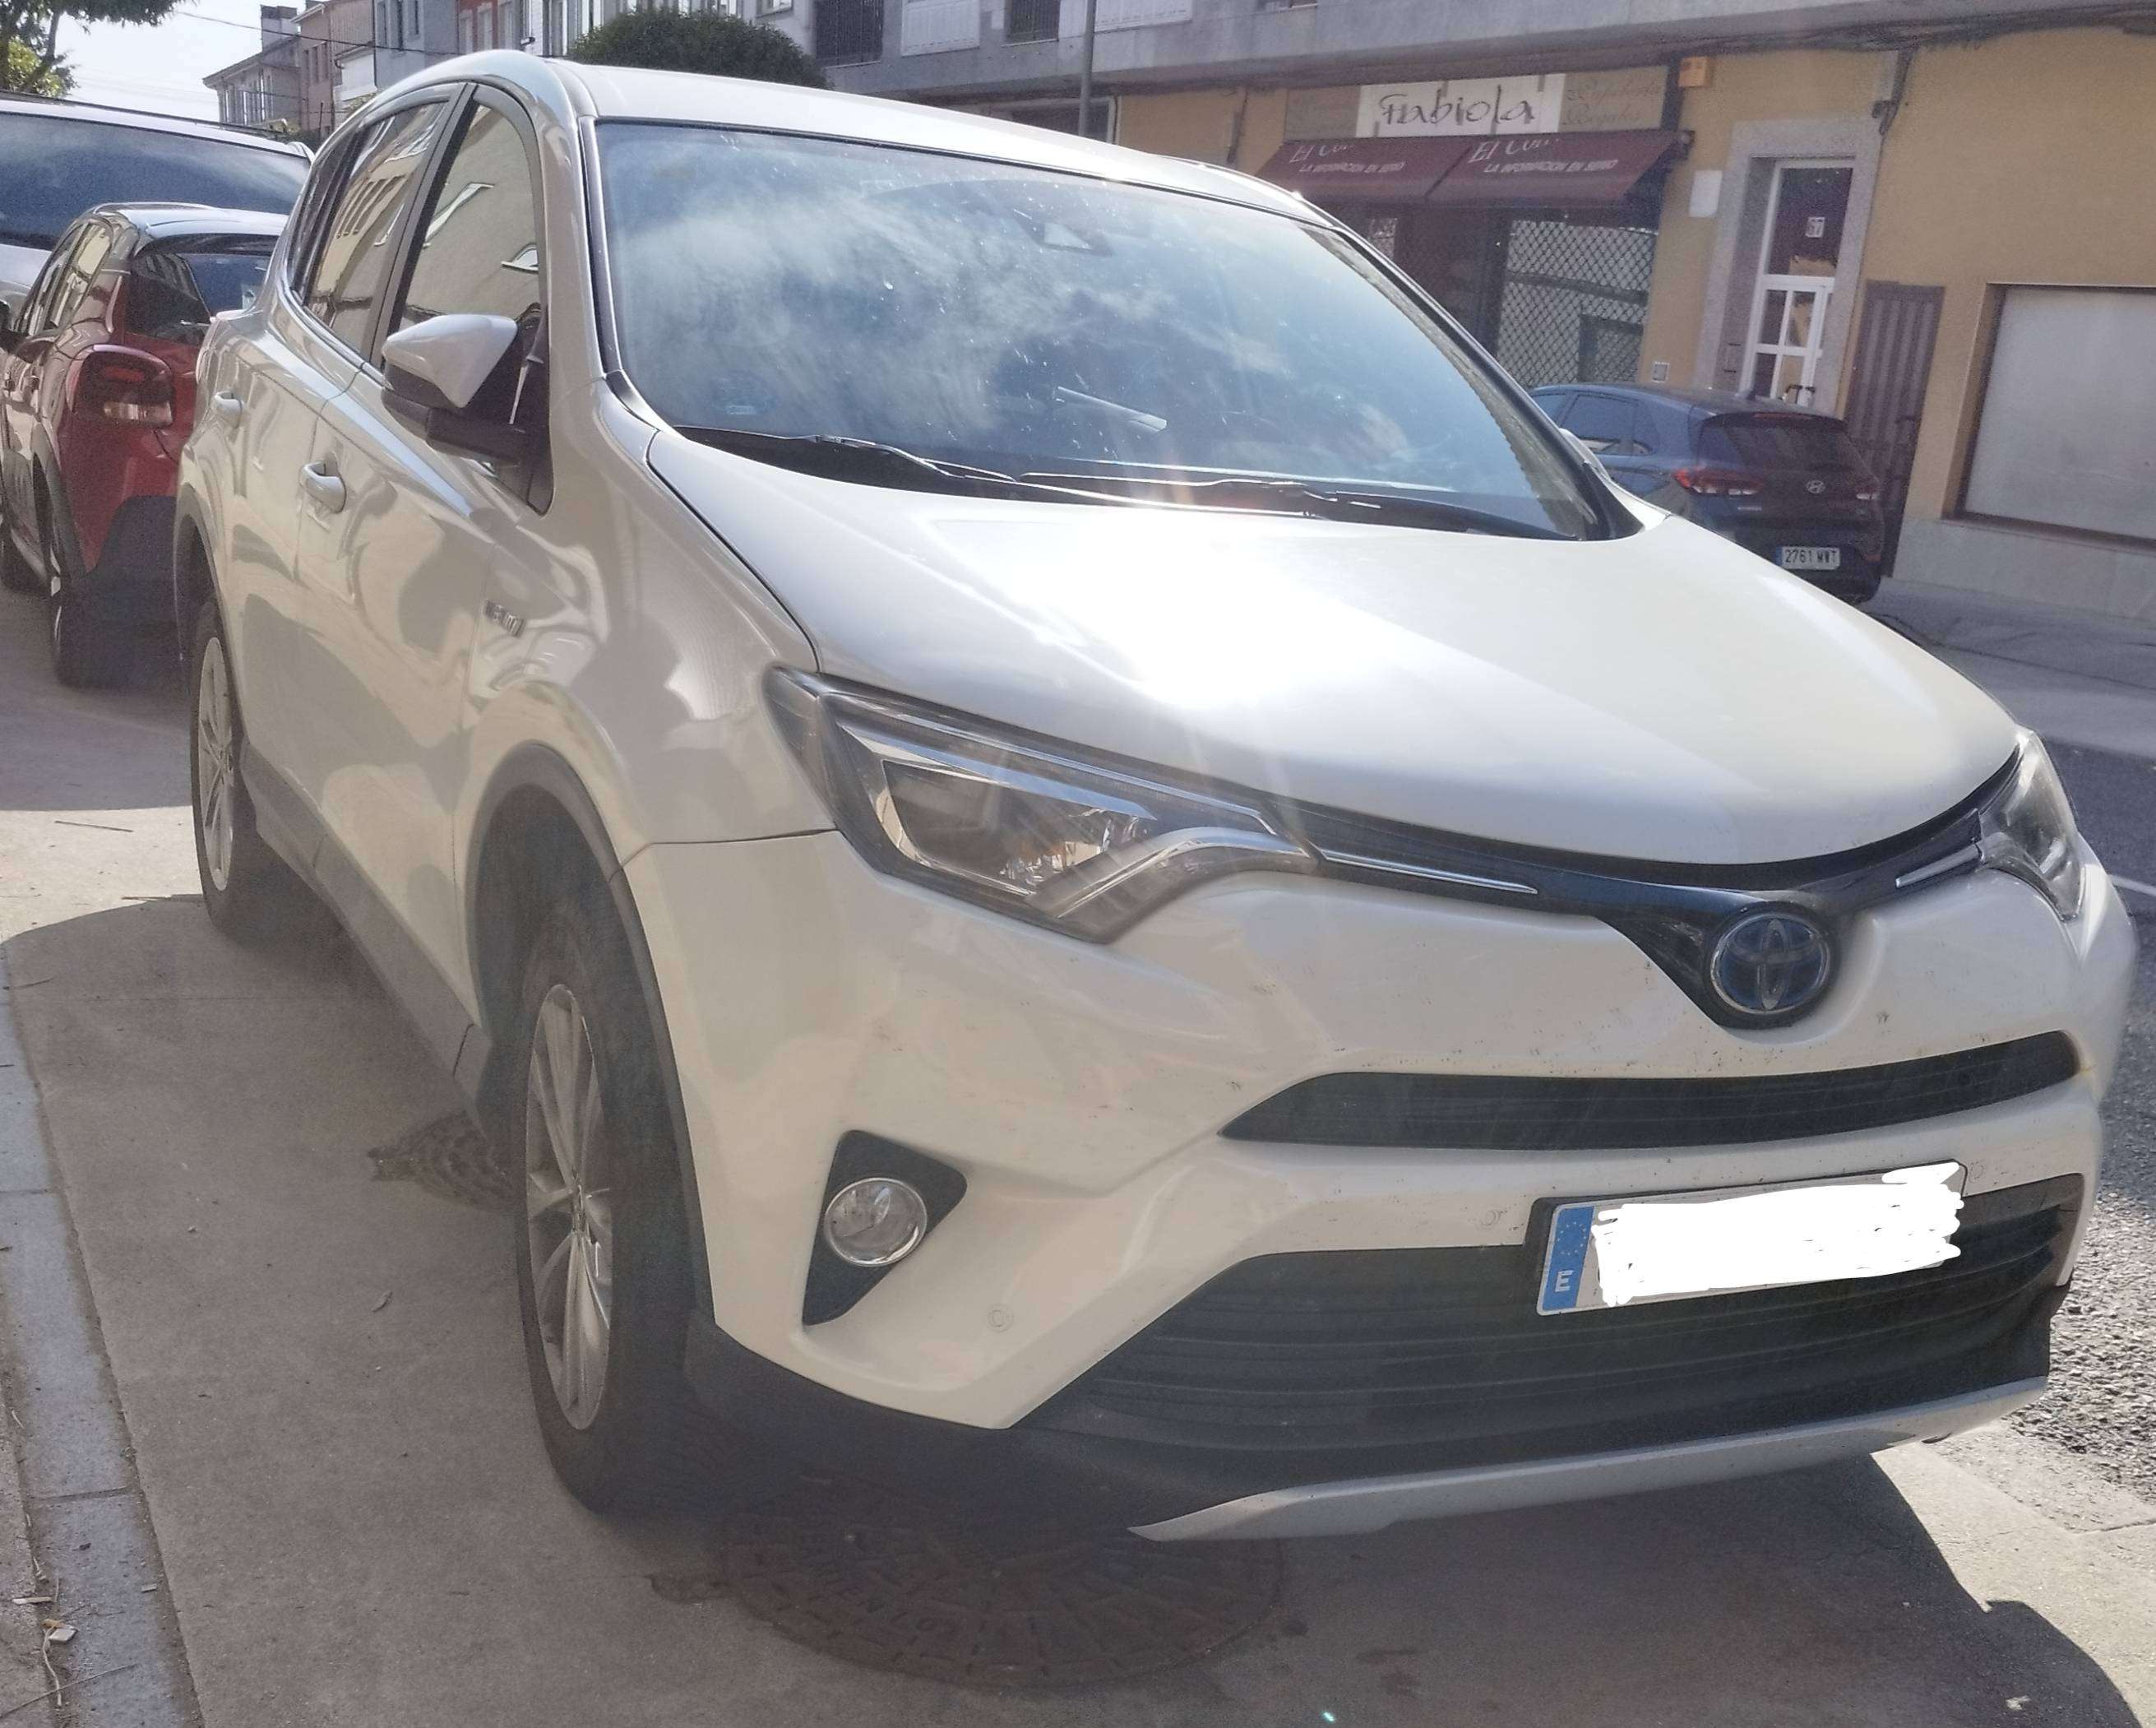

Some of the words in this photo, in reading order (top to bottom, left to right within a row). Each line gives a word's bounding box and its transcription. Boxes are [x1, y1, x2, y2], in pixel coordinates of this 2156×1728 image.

[1379, 84, 1535, 126] Fabiola
[1784, 549, 1812, 563] 2761
[1554, 1269, 1575, 1293] E
